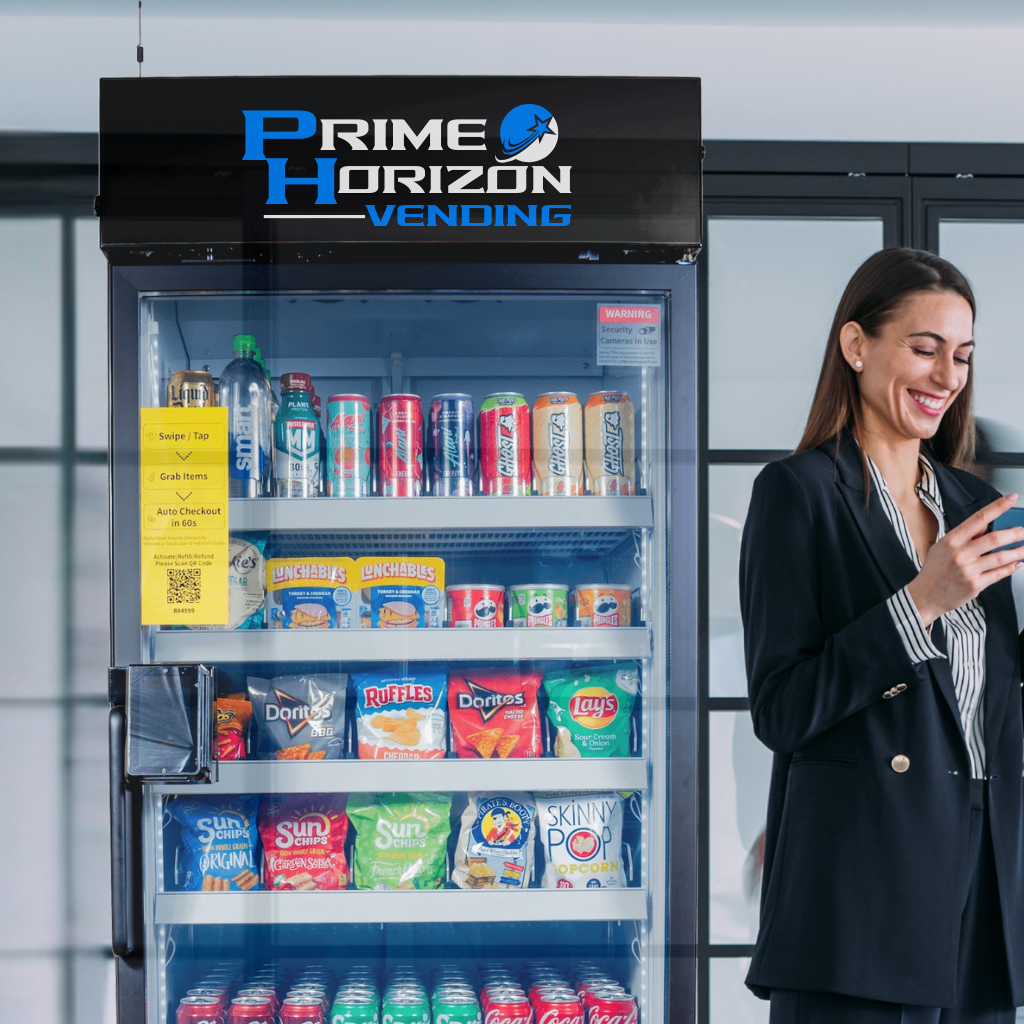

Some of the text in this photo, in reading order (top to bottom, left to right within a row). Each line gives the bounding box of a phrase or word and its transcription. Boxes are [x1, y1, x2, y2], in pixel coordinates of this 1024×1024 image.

[242, 109, 487, 161] PRIME
[265, 157, 572, 205] HORIZON
[365, 204, 572, 227] VENDING
[605, 309, 652, 319] WARNING
[601, 325, 633, 335] Security
[600, 336, 633, 345] Cameras
[158, 432, 186, 441] Swipe
[193, 432, 209, 441] Tap
[160, 472, 208, 480] Grab Items
[180, 507, 221, 515] Checkout
[171, 519, 197, 527] in 60s
[272, 563, 347, 584] LUNCHABLES
[361, 562, 436, 583] LUNCHABLES
[527, 614, 553, 627] PRINGLES
[592, 613, 619, 627] PRINGLES
[364, 683, 433, 709] RUFFLES
[459, 692, 524, 708] Doritos
[573, 696, 615, 719] Lay's
[310, 727, 334, 737] BBQ
[215, 829, 249, 840] CHIPS
[294, 836, 328, 846] CHIPS
[393, 838, 426, 848] CHIPS
[547, 826, 612, 862] POP
[553, 860, 619, 875] OPCORN
